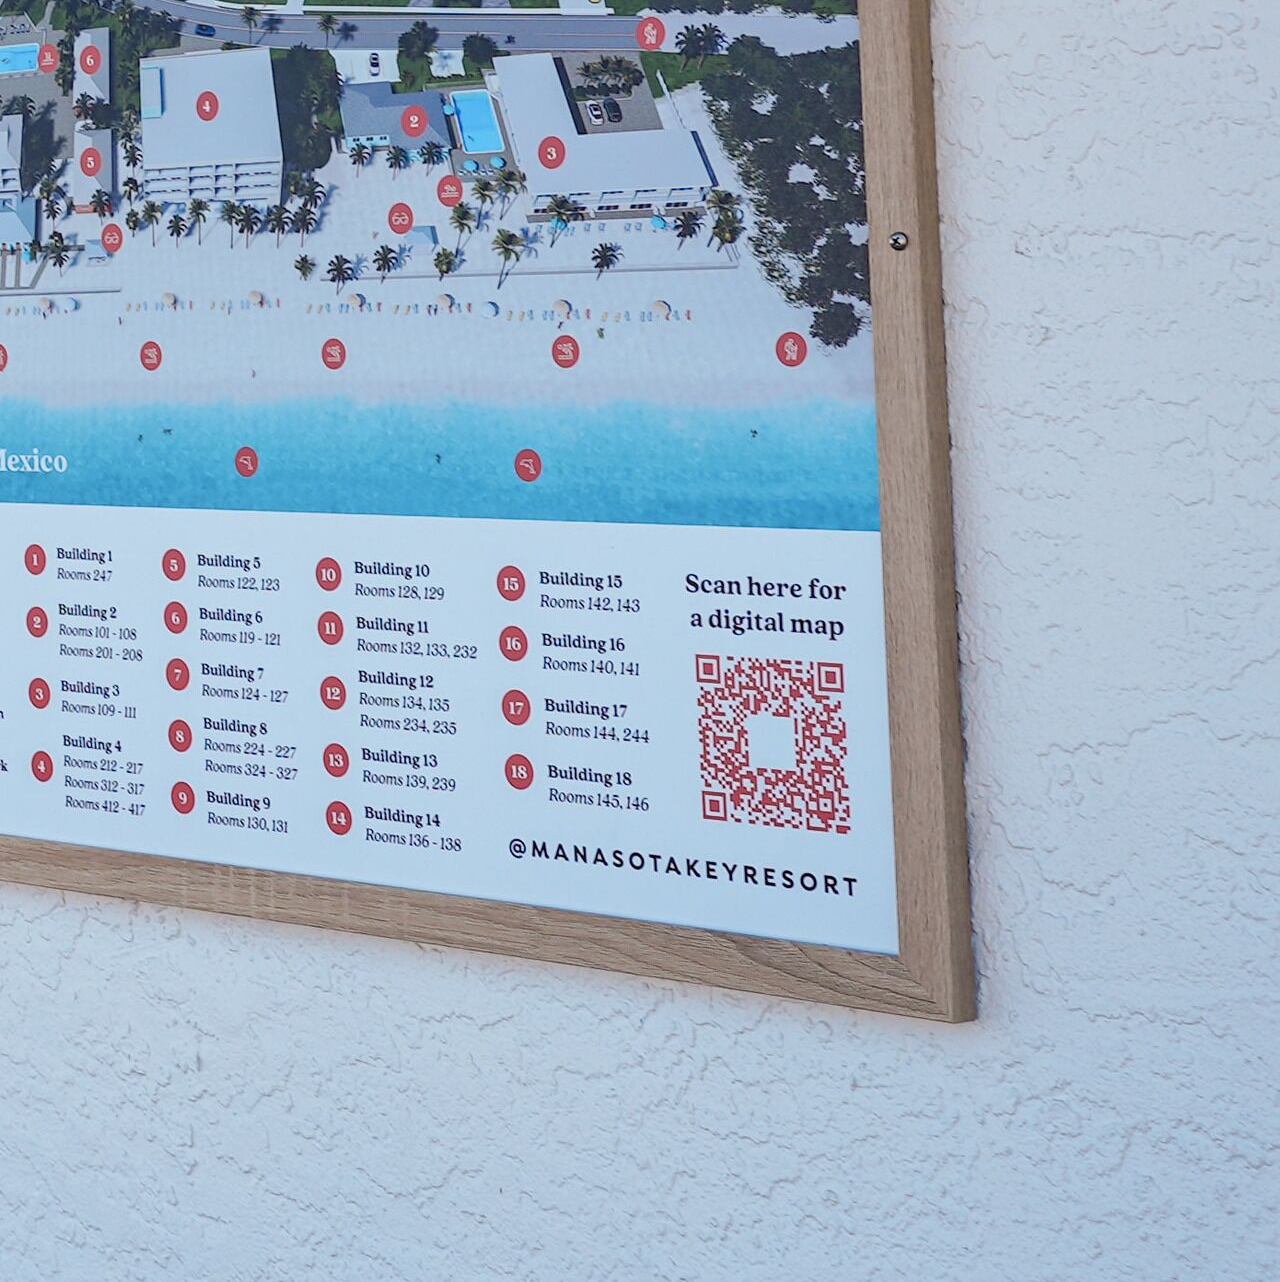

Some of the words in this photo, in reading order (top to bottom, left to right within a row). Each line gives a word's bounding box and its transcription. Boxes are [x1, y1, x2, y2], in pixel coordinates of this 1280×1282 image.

[86, 54, 95, 67] 6
[202, 100, 211, 113] 4
[409, 115, 419, 128] 2
[546, 147, 557, 160] 3
[86, 157, 95, 169] 5
[32, 553, 38, 566] 1
[56, 547, 106, 565] Building
[107, 550, 112, 562] 1
[197, 554, 251, 572] Building
[253, 556, 260, 569] 5
[169, 559, 179, 572] 5
[354, 561, 412, 580] Building
[415, 564, 430, 577] 10
[321, 568, 337, 582] 10
[503, 577, 519, 591] 15
[539, 571, 604, 591] Building
[607, 574, 622, 588] 15
[685, 573, 742, 595] Scan
[746, 576, 802, 598] here
[807, 577, 846, 600] for
[58, 603, 107, 621] Building
[109, 606, 116, 619] 2
[540, 594, 585, 609] Rooms
[588, 597, 613, 612] 142,
[617, 598, 640, 612] 143
[33, 615, 41, 629] 2
[171, 611, 181, 625] 6
[199, 607, 253, 626] Building
[254, 610, 263, 623] 6
[690, 612, 702, 627] a
[708, 608, 784, 636] digital
[790, 618, 844, 641] map
[324, 621, 337, 635] 11
[356, 616, 415, 636] Building
[417, 620, 429, 633] 11
[505, 637, 522, 651] 16
[541, 633, 607, 654] Building
[609, 637, 625, 651] 16
[173, 668, 182, 681] 7
[201, 663, 254, 682] Building
[257, 667, 264, 679] 7
[542, 656, 587, 672] Rooms
[590, 659, 617, 676] 140,
[620, 661, 639, 676] 141
[60, 679, 110, 699] Building
[112, 684, 120, 696] 3
[358, 670, 416, 690] Building
[419, 675, 434, 688] 12
[35, 687, 44, 701] 3
[326, 687, 341, 701] 12
[509, 701, 525, 715] 17
[544, 698, 609, 720] Building
[612, 704, 627, 717] 17
[203, 717, 257, 737] Building
[259, 722, 267, 735] 8
[546, 721, 590, 738] Rooms
[593, 725, 619, 742] 144,
[622, 727, 649, 743] 244
[62, 734, 112, 754] Building
[114, 740, 121, 752] 4
[175, 730, 185, 743] 8
[37, 760, 46, 773] 4
[328, 753, 344, 768] 13
[361, 747, 420, 769] Building
[423, 754, 438, 767] 13
[511, 765, 528, 779] 18
[547, 764, 613, 788] Building
[616, 771, 632, 786] 18
[178, 791, 188, 805] 9
[206, 790, 260, 812] Building
[262, 796, 270, 809] 9
[549, 787, 594, 805] Rooms
[597, 793, 623, 810] 145,
[626, 796, 649, 811] 146
[331, 811, 347, 826] 14
[364, 806, 423, 829] Building
[425, 813, 440, 827] 14
[508, 838, 857, 896] @MANASOTAKEYRESORT
